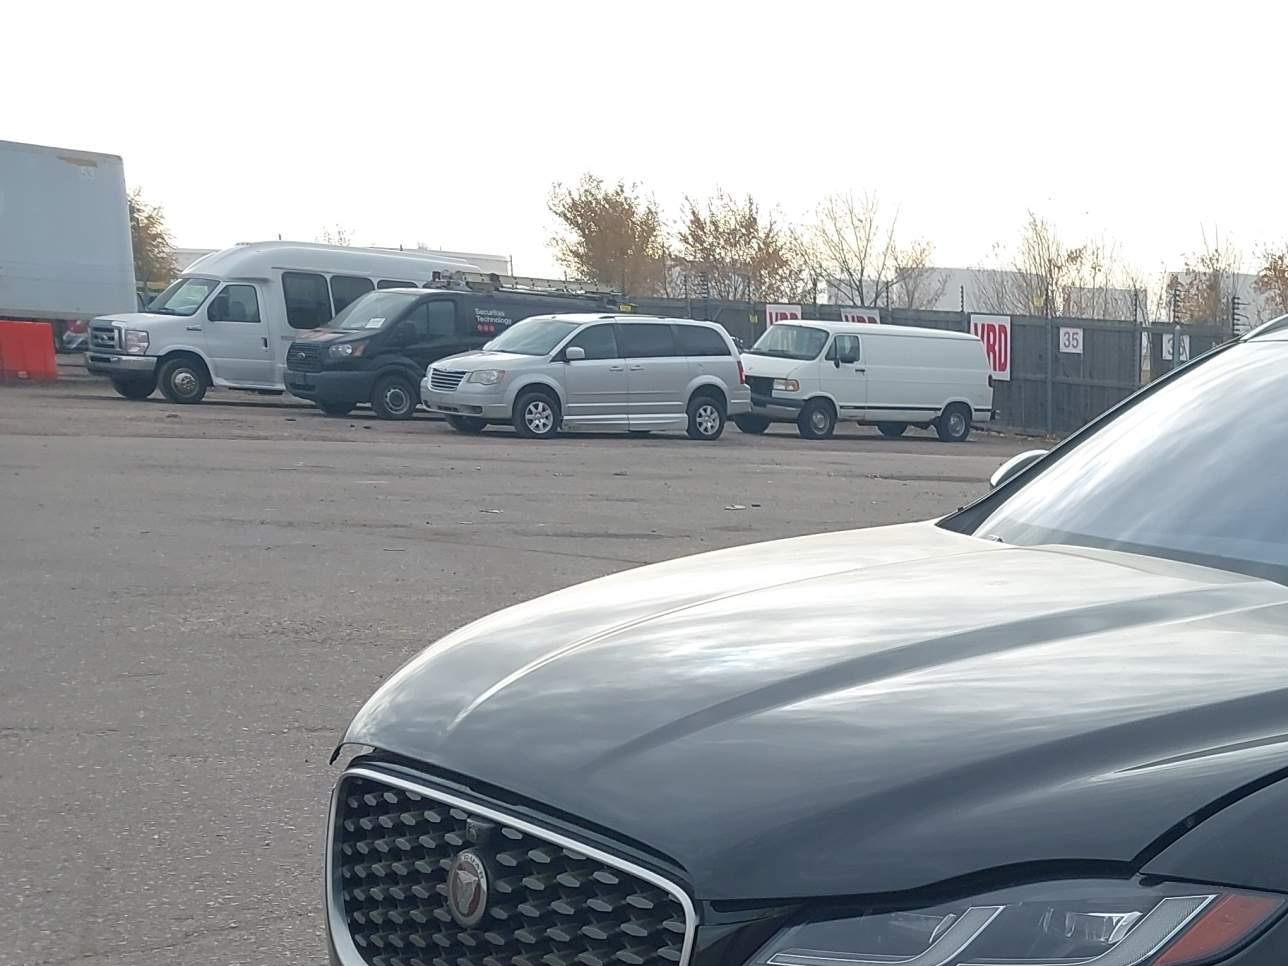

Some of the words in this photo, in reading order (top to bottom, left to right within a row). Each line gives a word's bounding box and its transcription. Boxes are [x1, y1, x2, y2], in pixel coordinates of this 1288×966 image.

[475, 308, 505, 316] Securitas
[476, 316, 512, 326] Technology
[1063, 331, 1080, 349] 35
